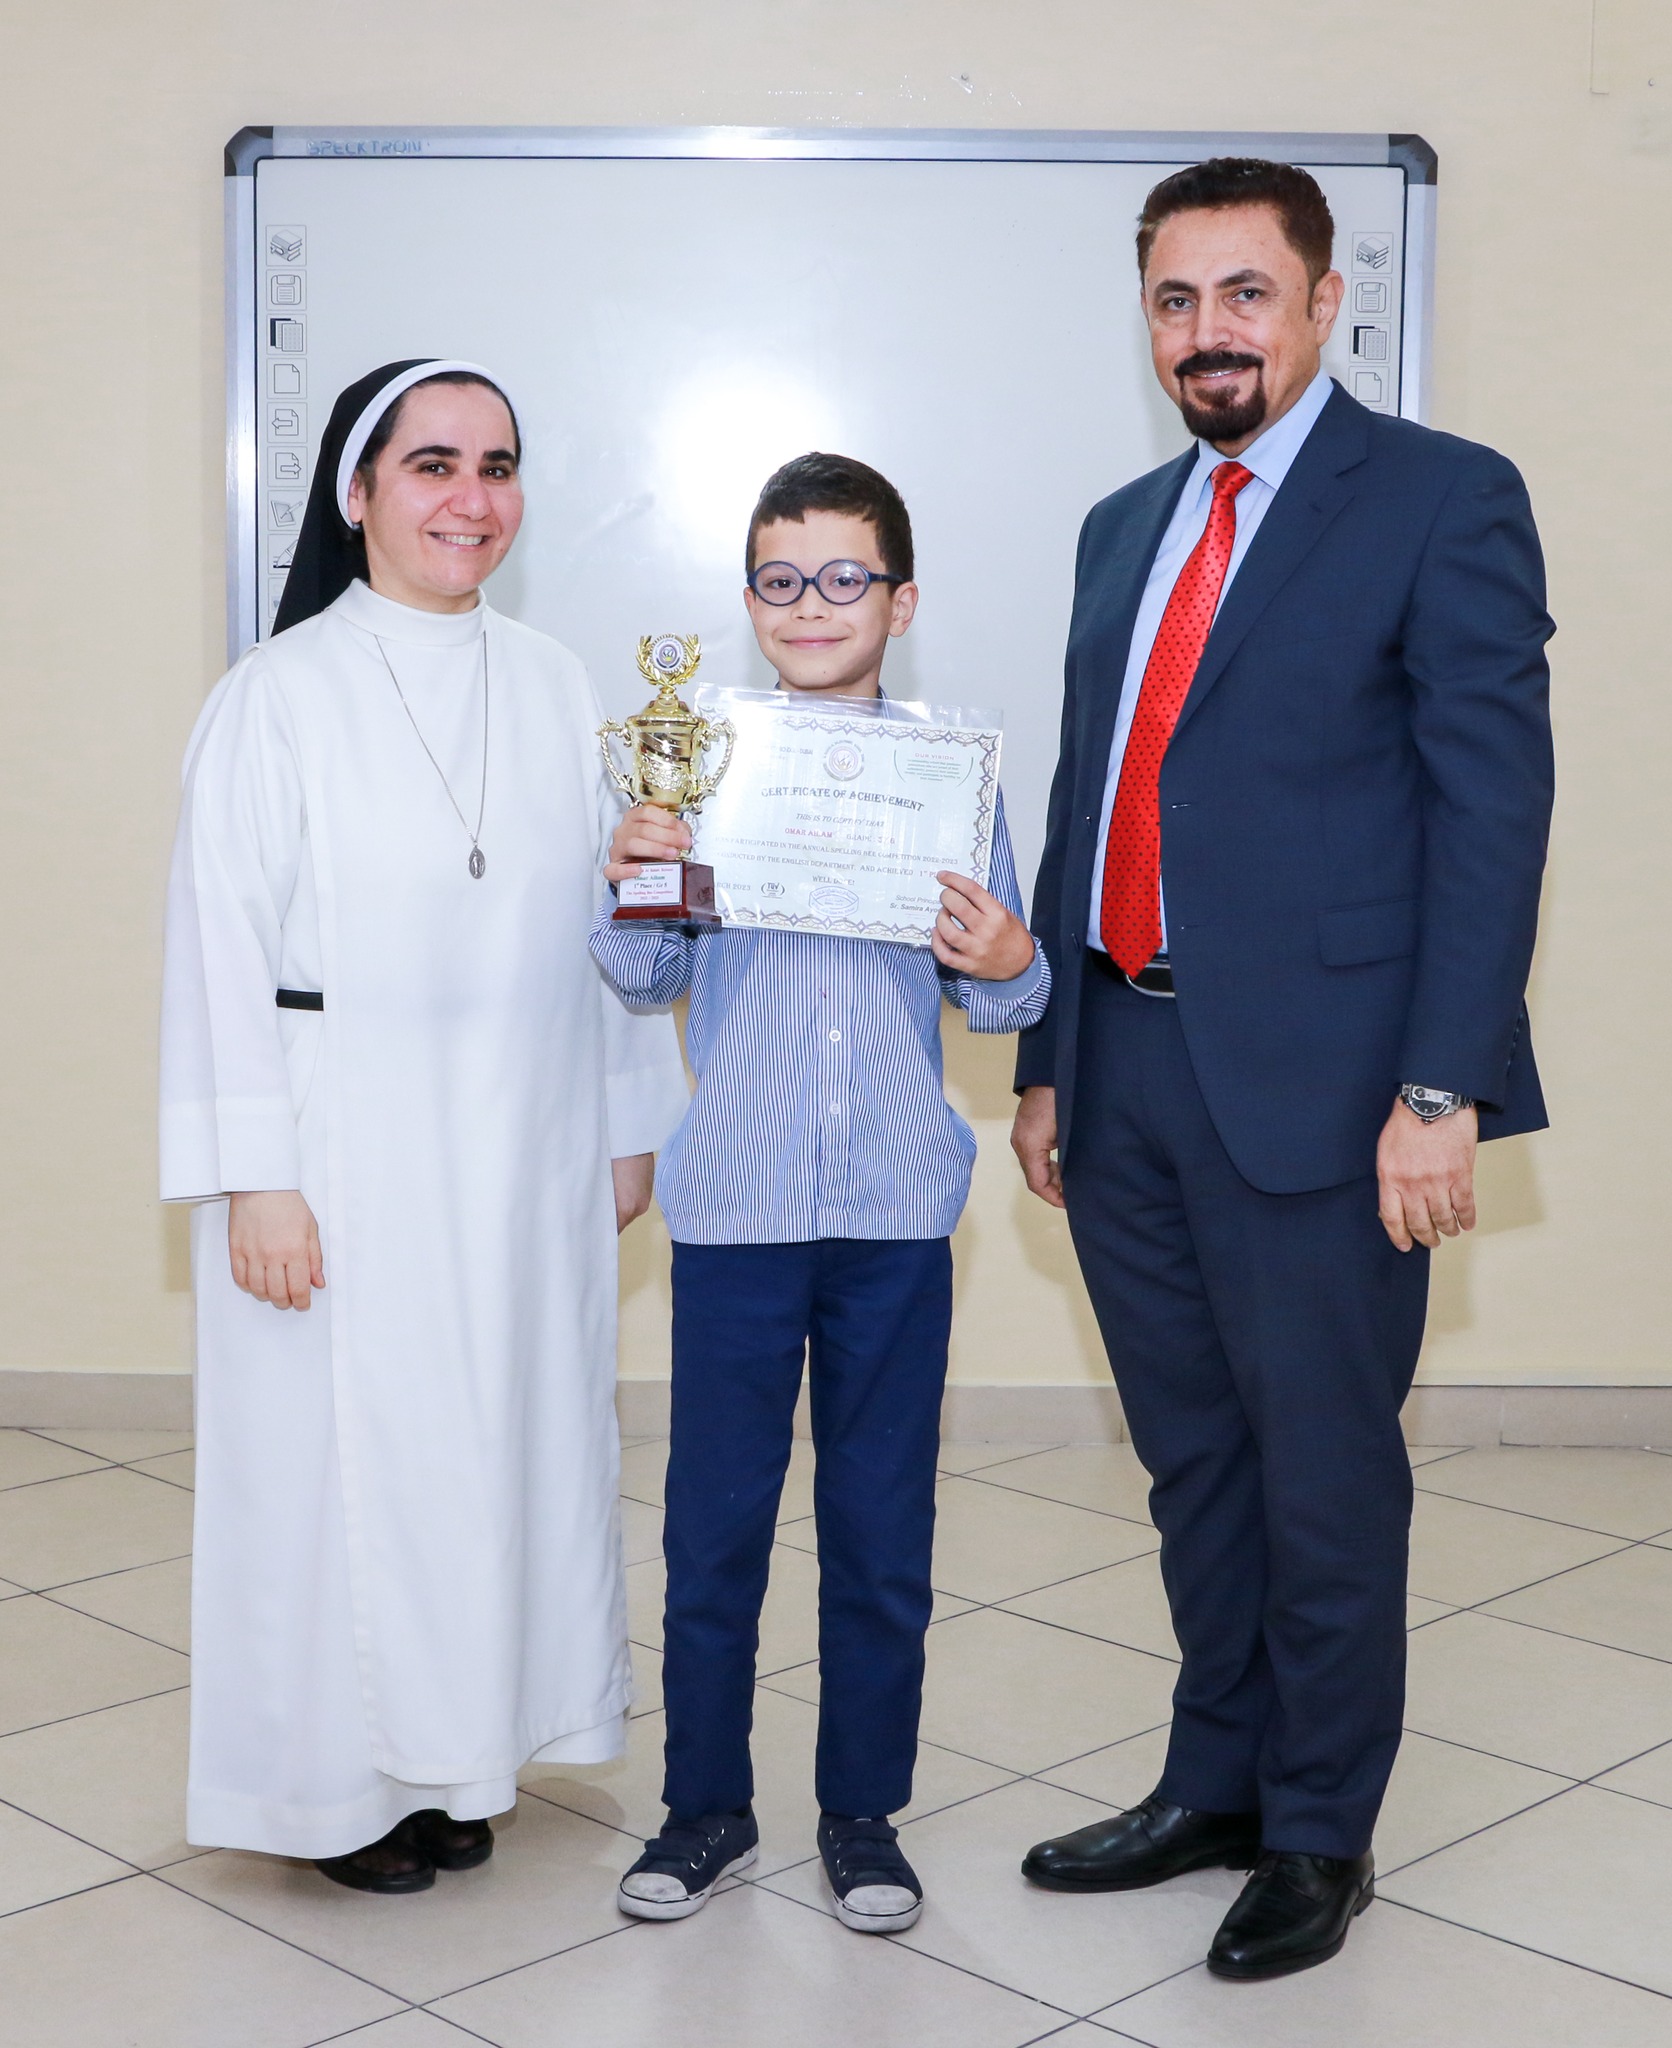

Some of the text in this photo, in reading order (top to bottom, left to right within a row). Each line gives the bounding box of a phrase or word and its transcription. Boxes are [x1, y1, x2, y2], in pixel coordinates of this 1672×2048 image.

[761, 786, 925, 812] CERTFICATE OF ACHIEVEMENT
[784, 827, 806, 836] OMAR
[802, 844, 830, 853] ANNUAL
[830, 847, 862, 856] SPELLING
[717, 851, 756, 860] ONDUCTED
[781, 858, 810, 866] ENGLISH
[859, 864, 875, 872] AND
[876, 866, 914, 876] ACHIEVED
[812, 875, 832, 884] WELL
[733, 883, 751, 891] 2023
[895, 894, 940, 905] School Principa
[900, 903, 924, 912] Samira
[924, 906, 939, 914] Ayo
